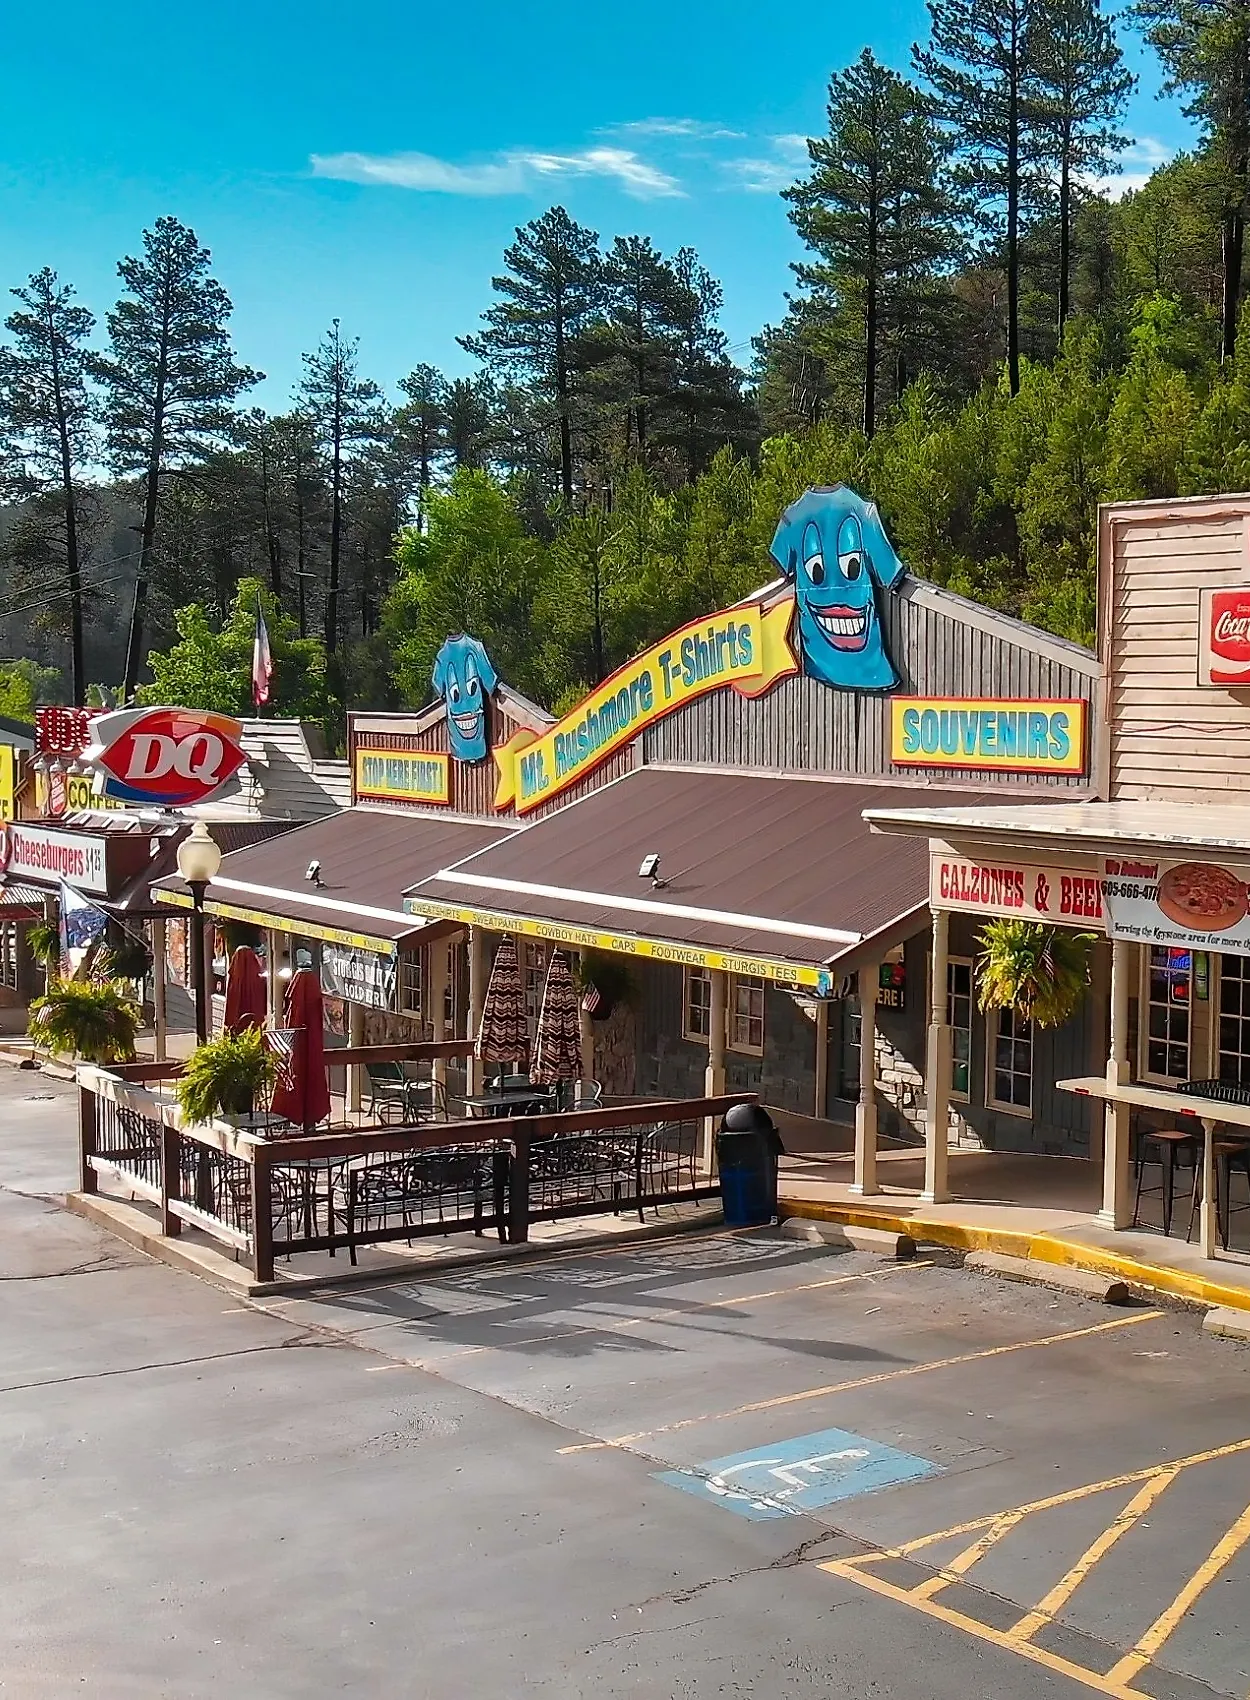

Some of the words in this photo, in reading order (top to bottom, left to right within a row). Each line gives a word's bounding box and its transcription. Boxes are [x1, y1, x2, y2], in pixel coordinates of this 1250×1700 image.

[35, 708, 103, 752] FUDG
[520, 749, 550, 800] Mt.
[554, 669, 655, 781] Rushmore
[658, 621, 752, 700] T-Shirts
[903, 708, 1070, 760] SOUVENIRS
[124, 733, 225, 785] DQ
[362, 756, 385, 788] STOP
[386, 757, 410, 791] HERE
[14, 832, 84, 877] Cheeseburgers
[940, 863, 1024, 908] CALZONES
[1034, 873, 1050, 912] &
[411, 901, 461, 920] SWEATSHIRTS
[472, 912, 524, 931] SWEATPANTS
[536, 925, 573, 940] COWBOY
[575, 931, 597, 945] HATS
[611, 938, 636, 952] CAPS
[651, 945, 706, 965] FOOTWEAR
[721, 959, 766, 976] STURGIS
[770, 966, 797, 981] TEES
[1114, 922, 1140, 936] Serving
[1142, 926, 1153, 938] the
[1154, 926, 1186, 940] Keystone
[1188, 933, 1205, 943] area
[1206, 934, 1220, 945] for
[1221, 938, 1242, 947] more
[877, 988, 904, 1008] ERE!
